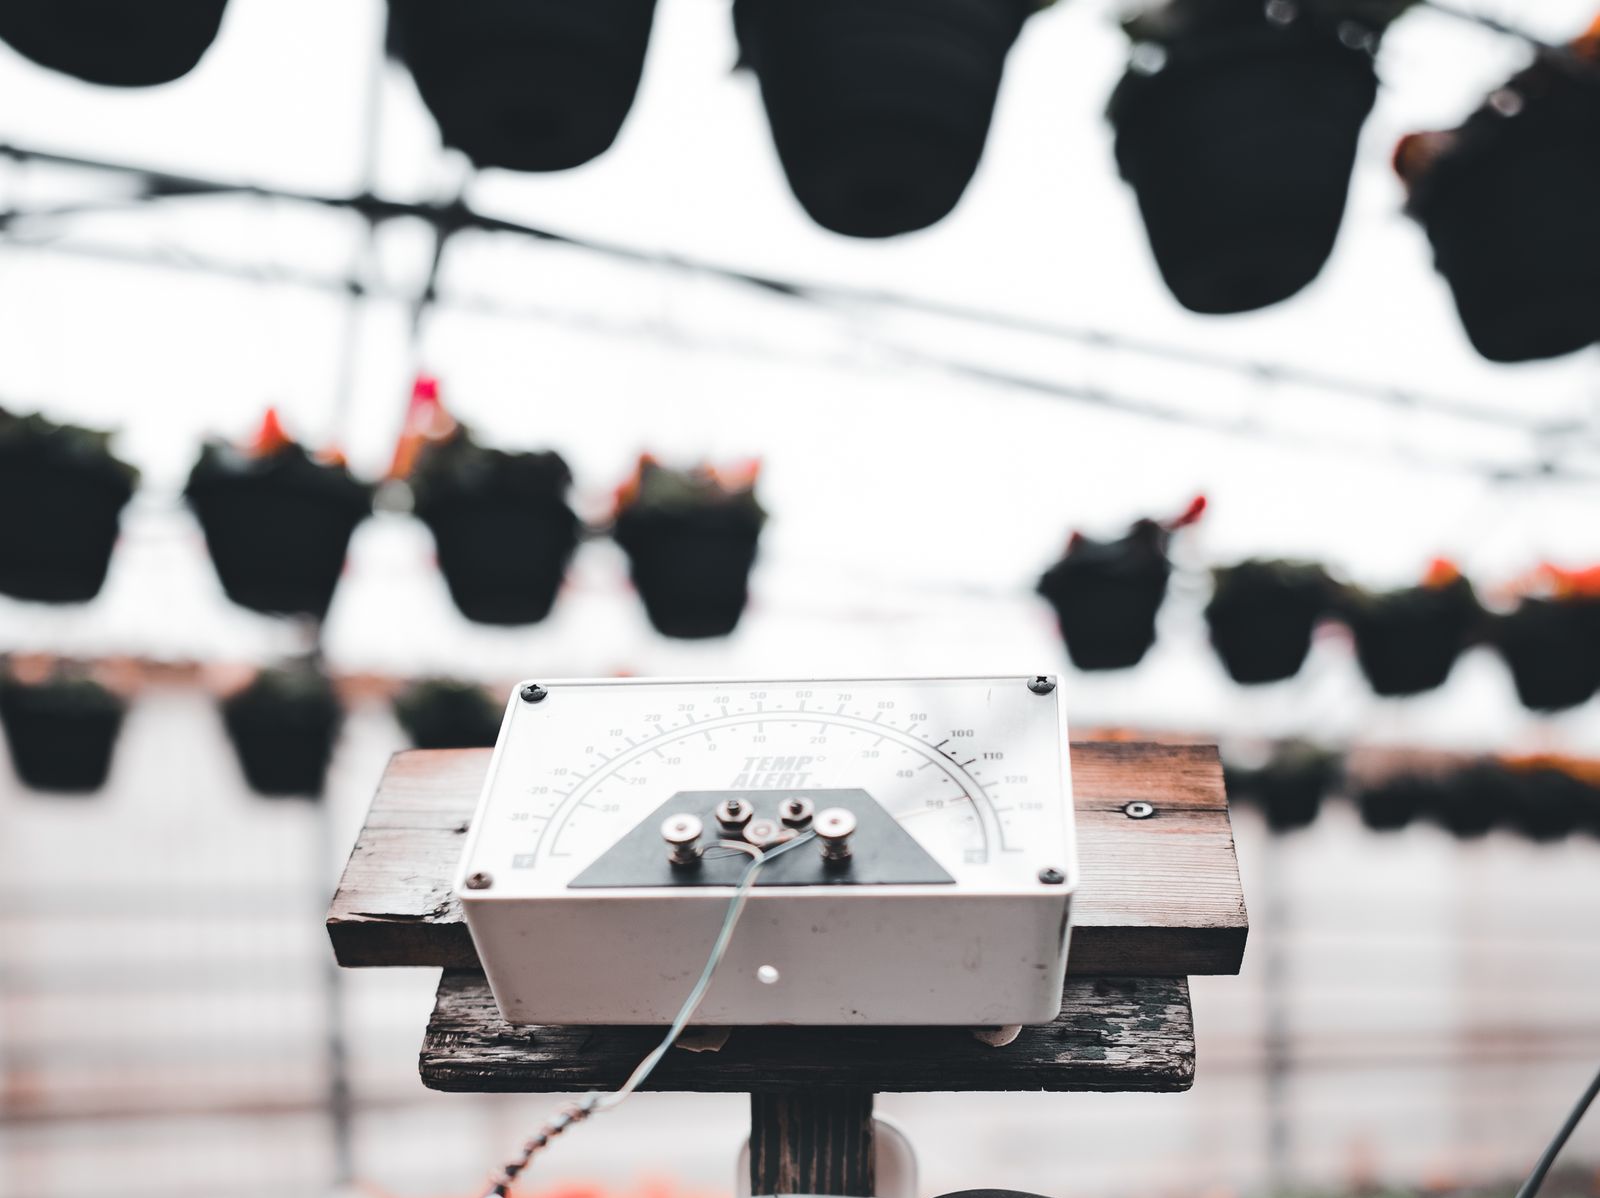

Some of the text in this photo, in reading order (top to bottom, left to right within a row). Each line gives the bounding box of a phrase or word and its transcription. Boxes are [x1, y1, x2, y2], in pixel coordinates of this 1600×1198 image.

[750, 691, 767, 700] 50
[795, 690, 813, 699] 60
[837, 693, 852, 702] 70
[713, 695, 730, 704] 40
[678, 704, 695, 712] 30
[877, 701, 895, 710] 80
[644, 714, 661, 722] 20
[910, 712, 928, 722] 90
[609, 729, 623, 737] 10
[950, 729, 974, 738] 100
[752, 735, 766, 744] 10
[810, 736, 827, 745] 20
[585, 745, 594, 754] 0
[708, 743, 717, 752] 0
[861, 750, 880, 759] 30
[983, 752, 1004, 761] 110
[896, 769, 914, 779] 40
[730, 772, 813, 789] ALERT
[1005, 776, 1028, 784] 120
